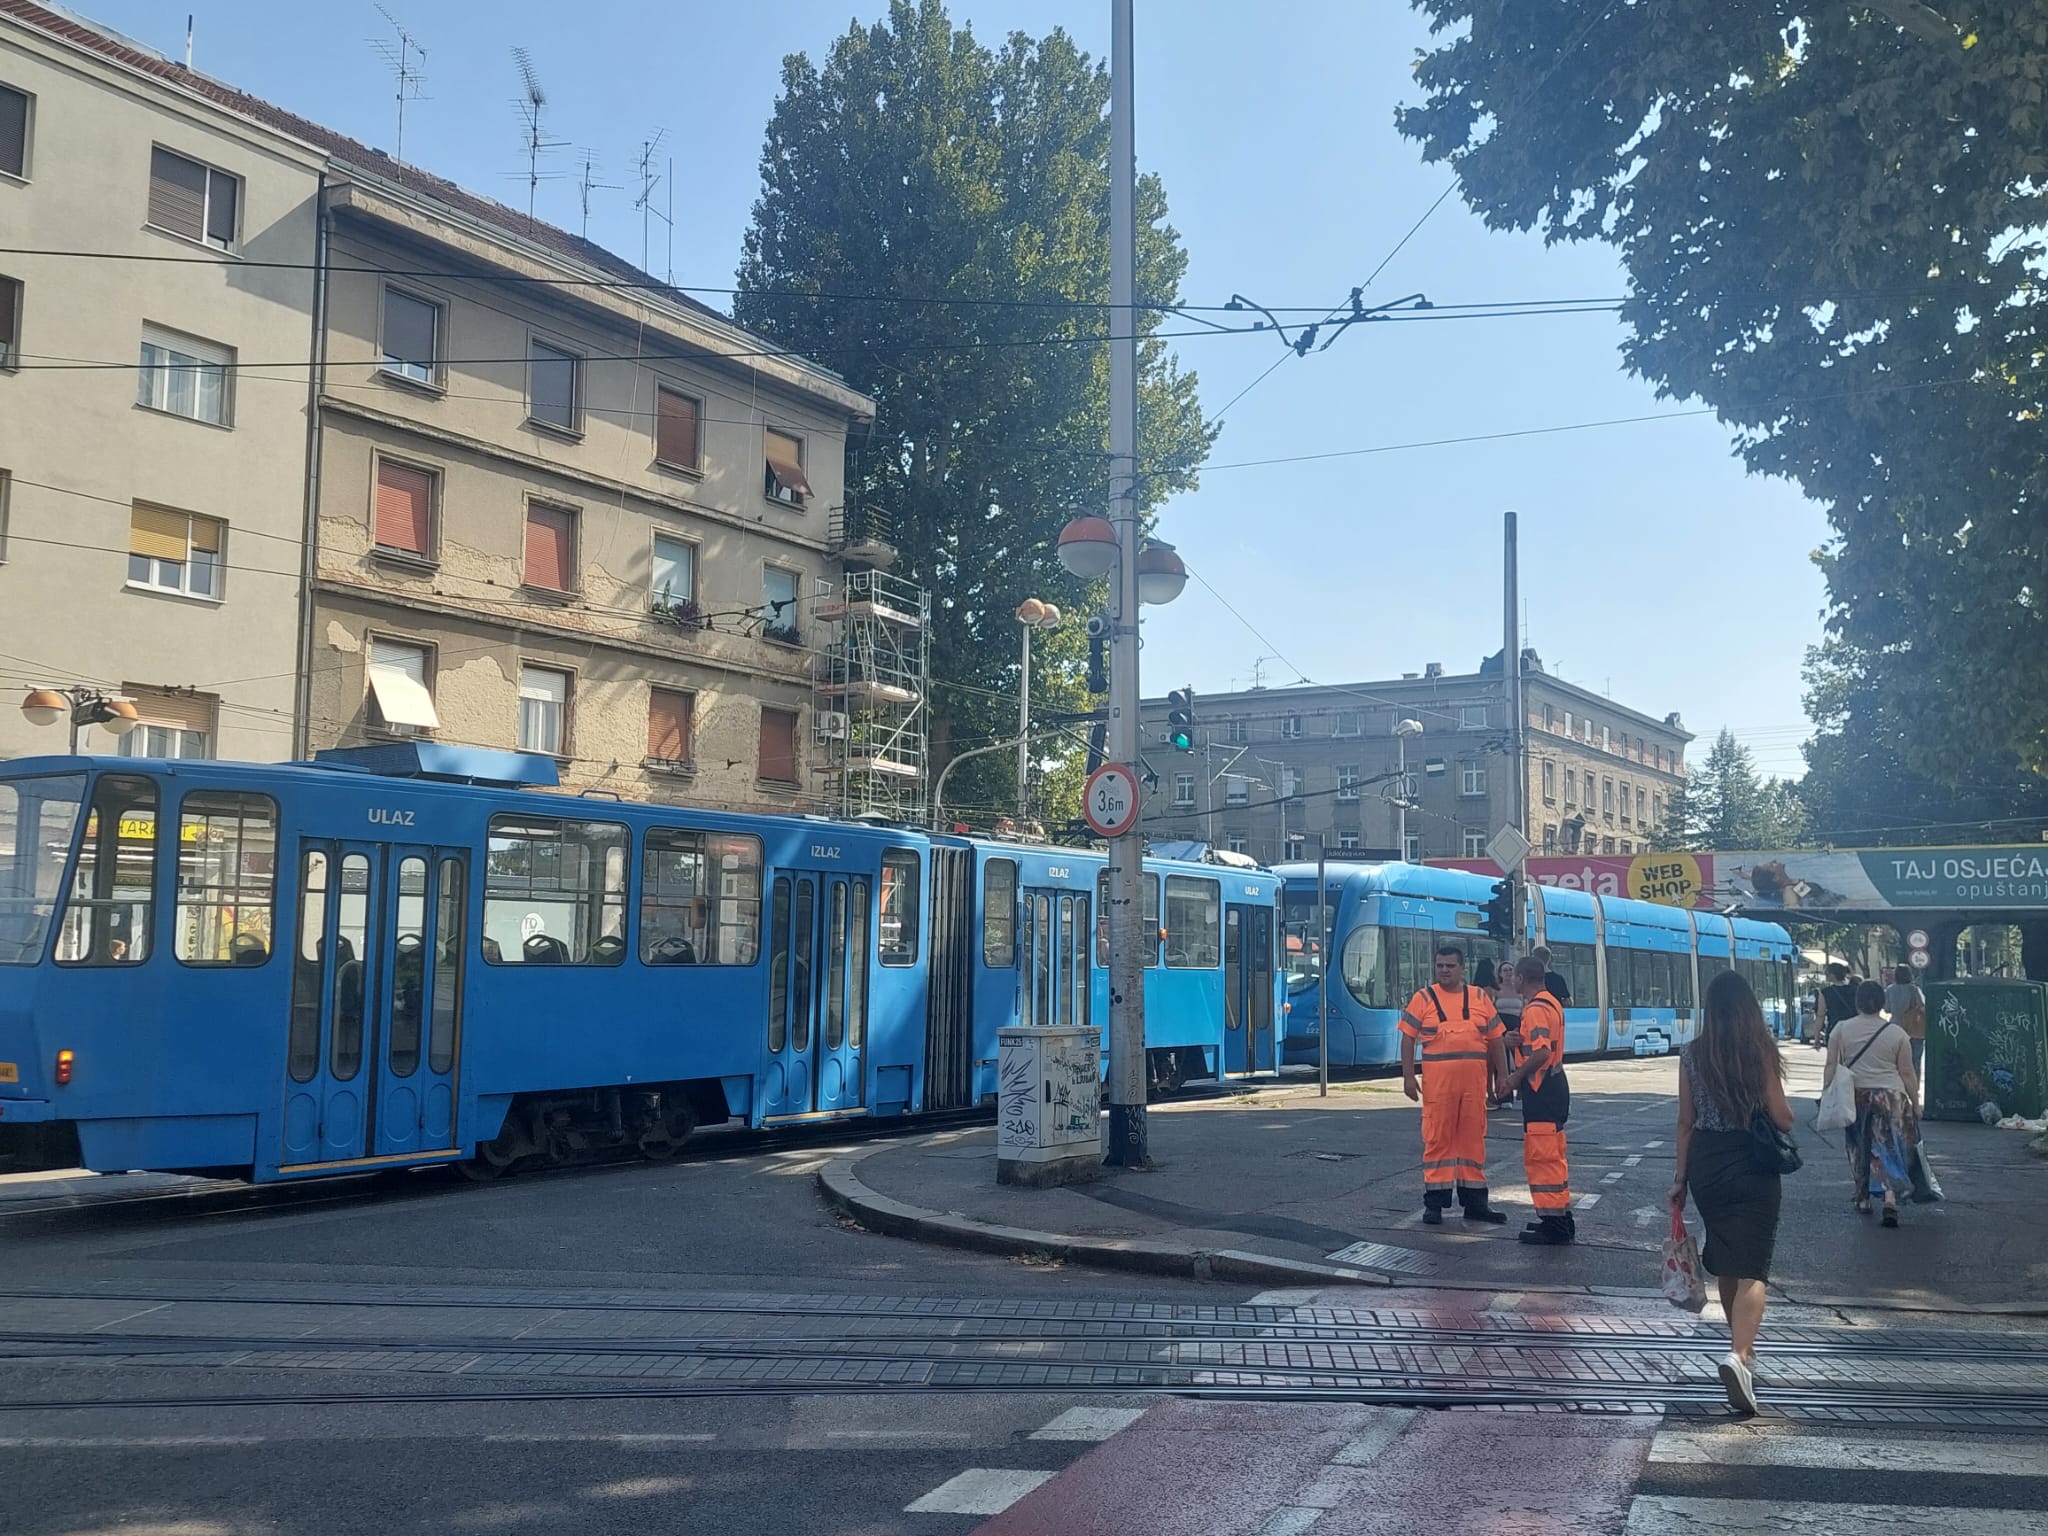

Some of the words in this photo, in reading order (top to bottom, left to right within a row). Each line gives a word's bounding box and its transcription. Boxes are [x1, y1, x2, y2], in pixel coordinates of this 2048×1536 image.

[1097, 790, 1124, 813] 3,6m
[368, 808, 415, 827] ULAZ
[811, 845, 841, 860] IZLAZ
[1048, 866, 1070, 879] IZLAZ
[1643, 863, 1684, 882] WEB
[1891, 859, 1936, 880] TAJ
[1244, 886, 1260, 896] ULAZ
[1639, 879, 1692, 900] SHOP
